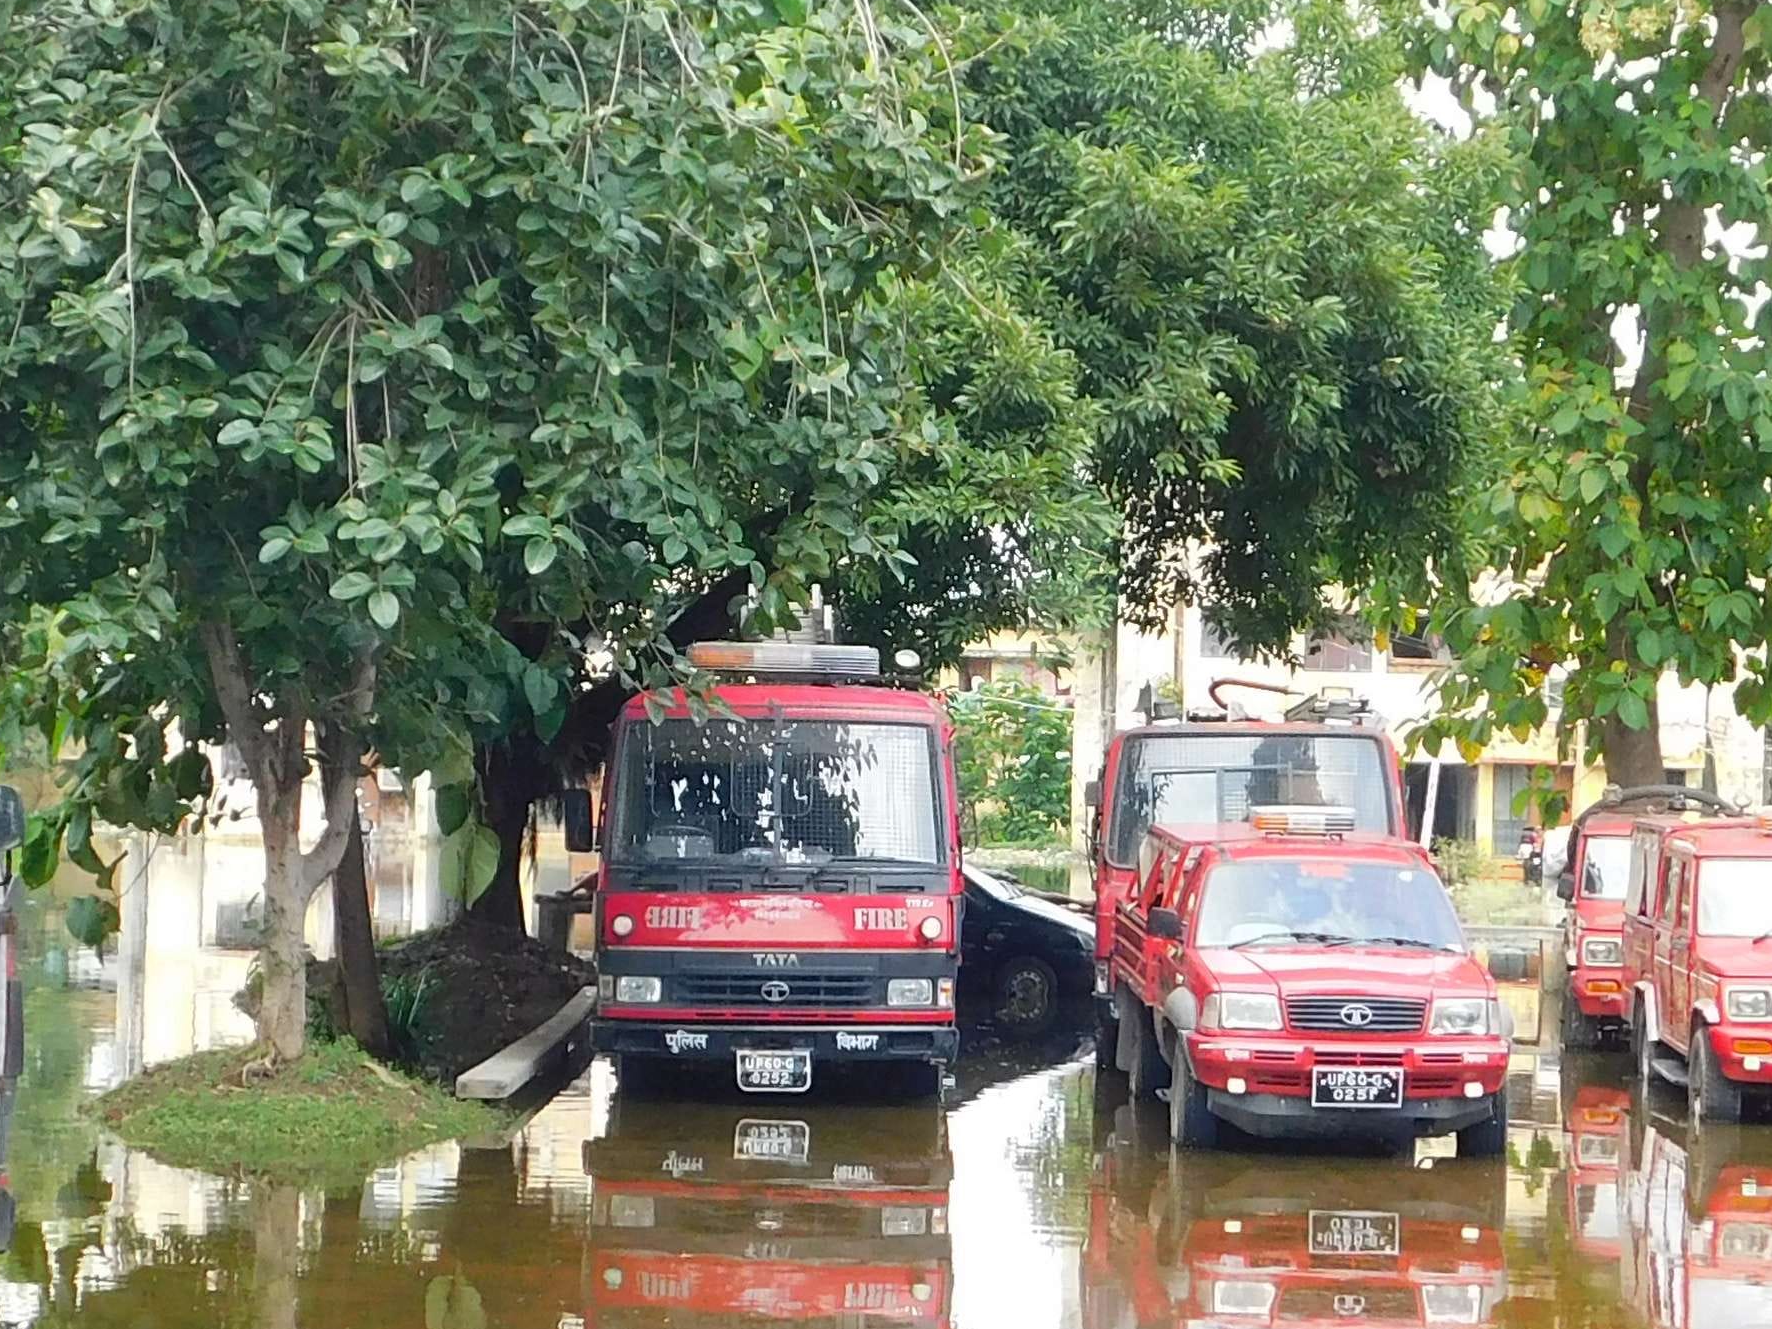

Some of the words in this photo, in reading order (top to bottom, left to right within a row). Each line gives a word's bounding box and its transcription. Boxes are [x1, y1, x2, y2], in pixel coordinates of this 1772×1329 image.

[853, 907, 908, 930] FIRE
[752, 953, 799, 968] TATA
[665, 1030, 708, 1054] पुलिस
[836, 1031, 879, 1051] विभाग
